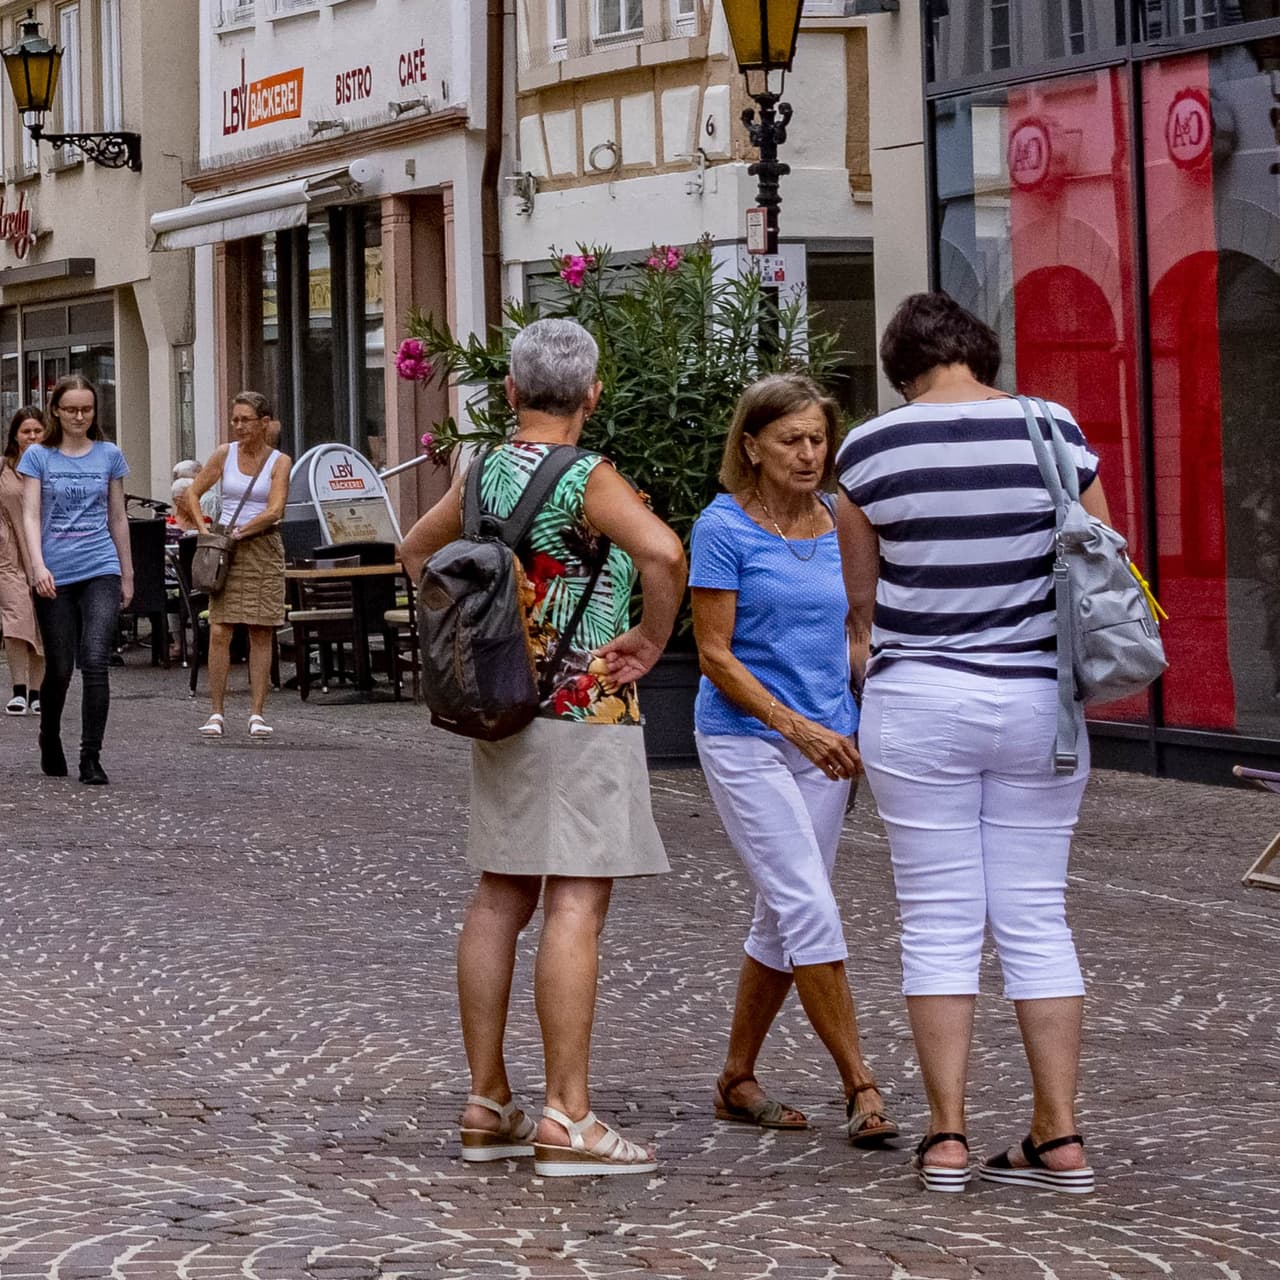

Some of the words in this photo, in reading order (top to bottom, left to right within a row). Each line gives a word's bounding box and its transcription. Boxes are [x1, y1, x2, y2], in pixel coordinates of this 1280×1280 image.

[398, 38, 427, 88] CAFÉ
[250, 78, 298, 123] BÄCKEREI
[335, 64, 372, 106] BISTRO
[705, 114, 715, 136] 6
